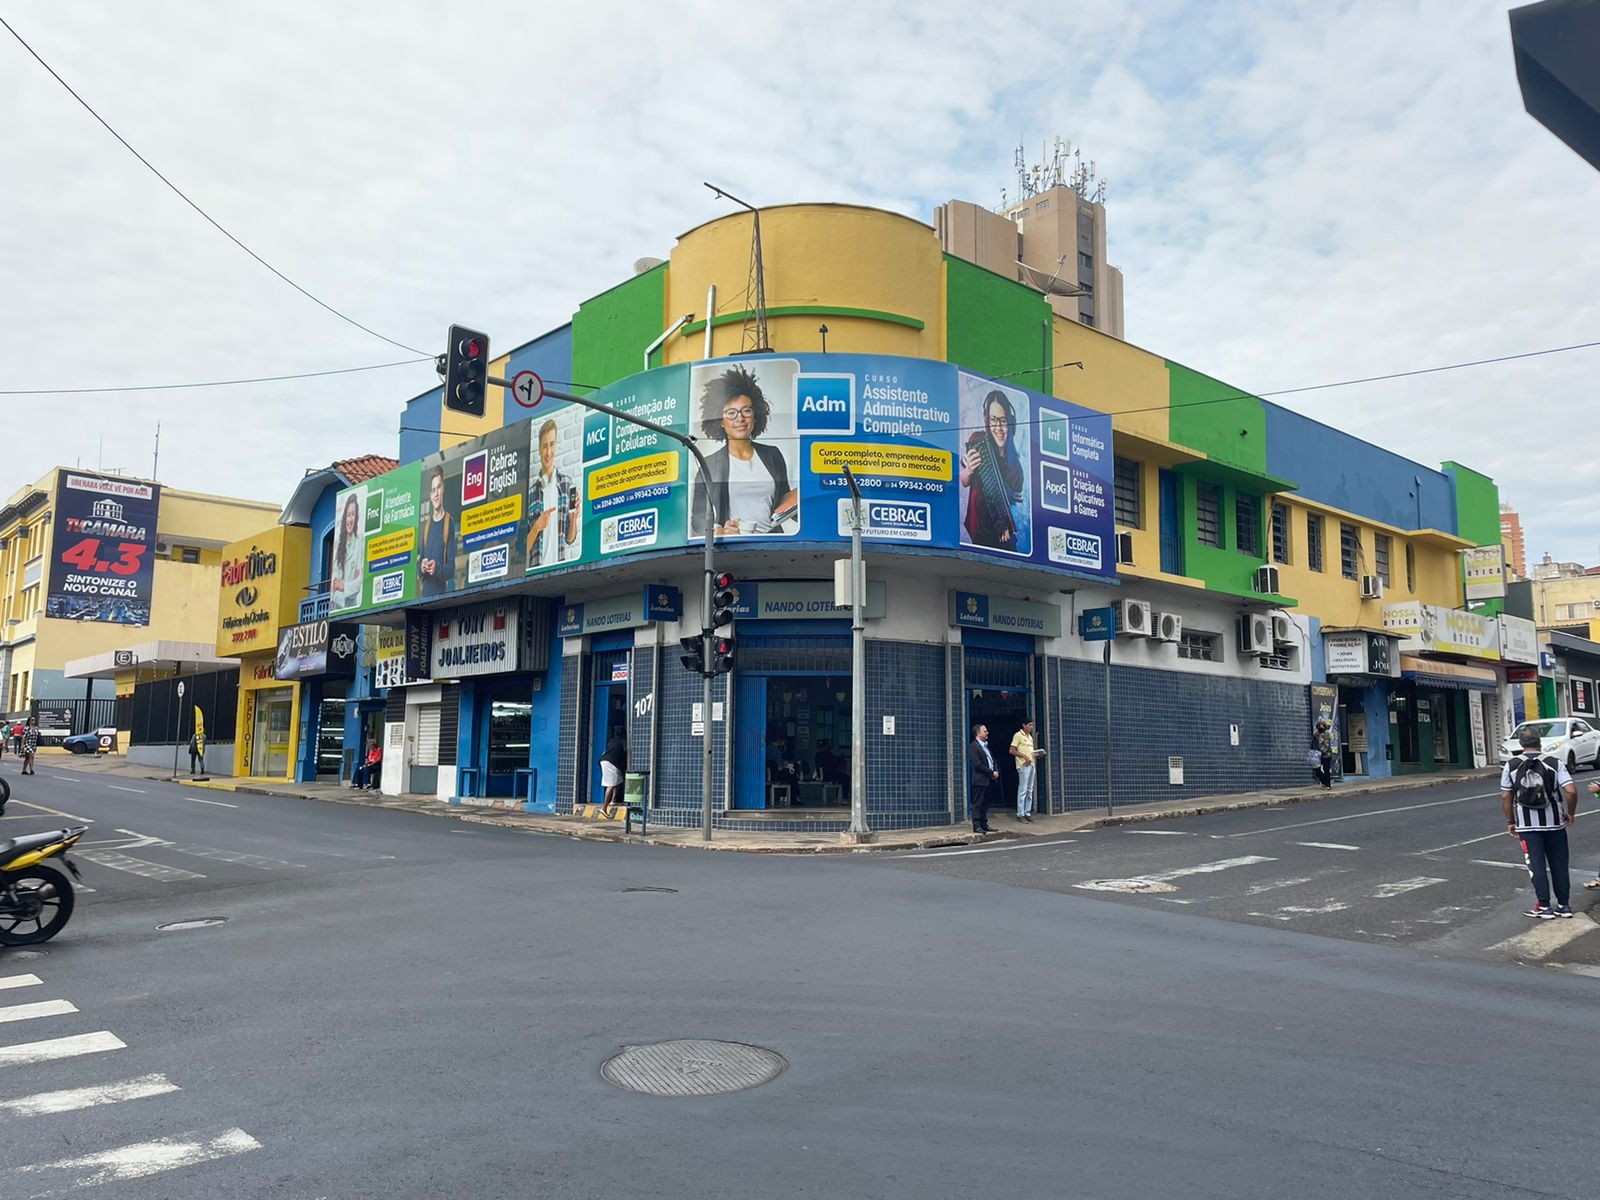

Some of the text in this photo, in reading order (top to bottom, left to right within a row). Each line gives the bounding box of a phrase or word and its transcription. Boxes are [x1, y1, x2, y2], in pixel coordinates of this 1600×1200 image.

[865, 374, 898, 383] CURSO
[863, 385, 928, 403] Assistente
[664, 396, 676, 410] de
[802, 396, 846, 412] Adm
[863, 401, 950, 424] Administrativo
[863, 417, 922, 437] Completo
[1048, 427, 1060, 442] Inf
[587, 427, 606, 447] MCC
[615, 433, 657, 454] e Celulares
[1072, 432, 1104, 450] Informática
[844, 450, 884, 459] completo,
[886, 452, 940, 464] empreendedor
[1072, 444, 1099, 460] Completa
[490, 451, 518, 472] Cebrac
[824, 457, 880, 466] indispensável
[908, 462, 942, 472] mercado.
[466, 472, 482, 486] Eng
[489, 470, 517, 493] English
[898, 481, 943, 492] 99342-0015
[1073, 478, 1102, 495] Criação de
[1046, 480, 1066, 495] AppG
[1073, 491, 1105, 507] Aplicativos
[871, 507, 925, 523] CEBRAC
[1079, 505, 1098, 518] Games
[619, 515, 653, 534] CEBRAC
[1067, 537, 1098, 554] CEBRAC
[62, 538, 147, 575] 4.3
[482, 550, 505, 566] CEBRAC
[66, 574, 126, 588] SINTONIZE
[63, 583, 138, 597] NOVO CANAL
[765, 601, 804, 612] NANDO
[1384, 609, 1417, 618] NOSSA
[459, 613, 485, 636] TONY
[561, 611, 631, 632] Loterias NANDO LOTERIAS
[960, 612, 1044, 630] Loterias NANDO LOTERIAS
[292, 621, 328, 648] ESTILO
[411, 625, 420, 659] TONY
[439, 641, 506, 668] JOALHEIROS
